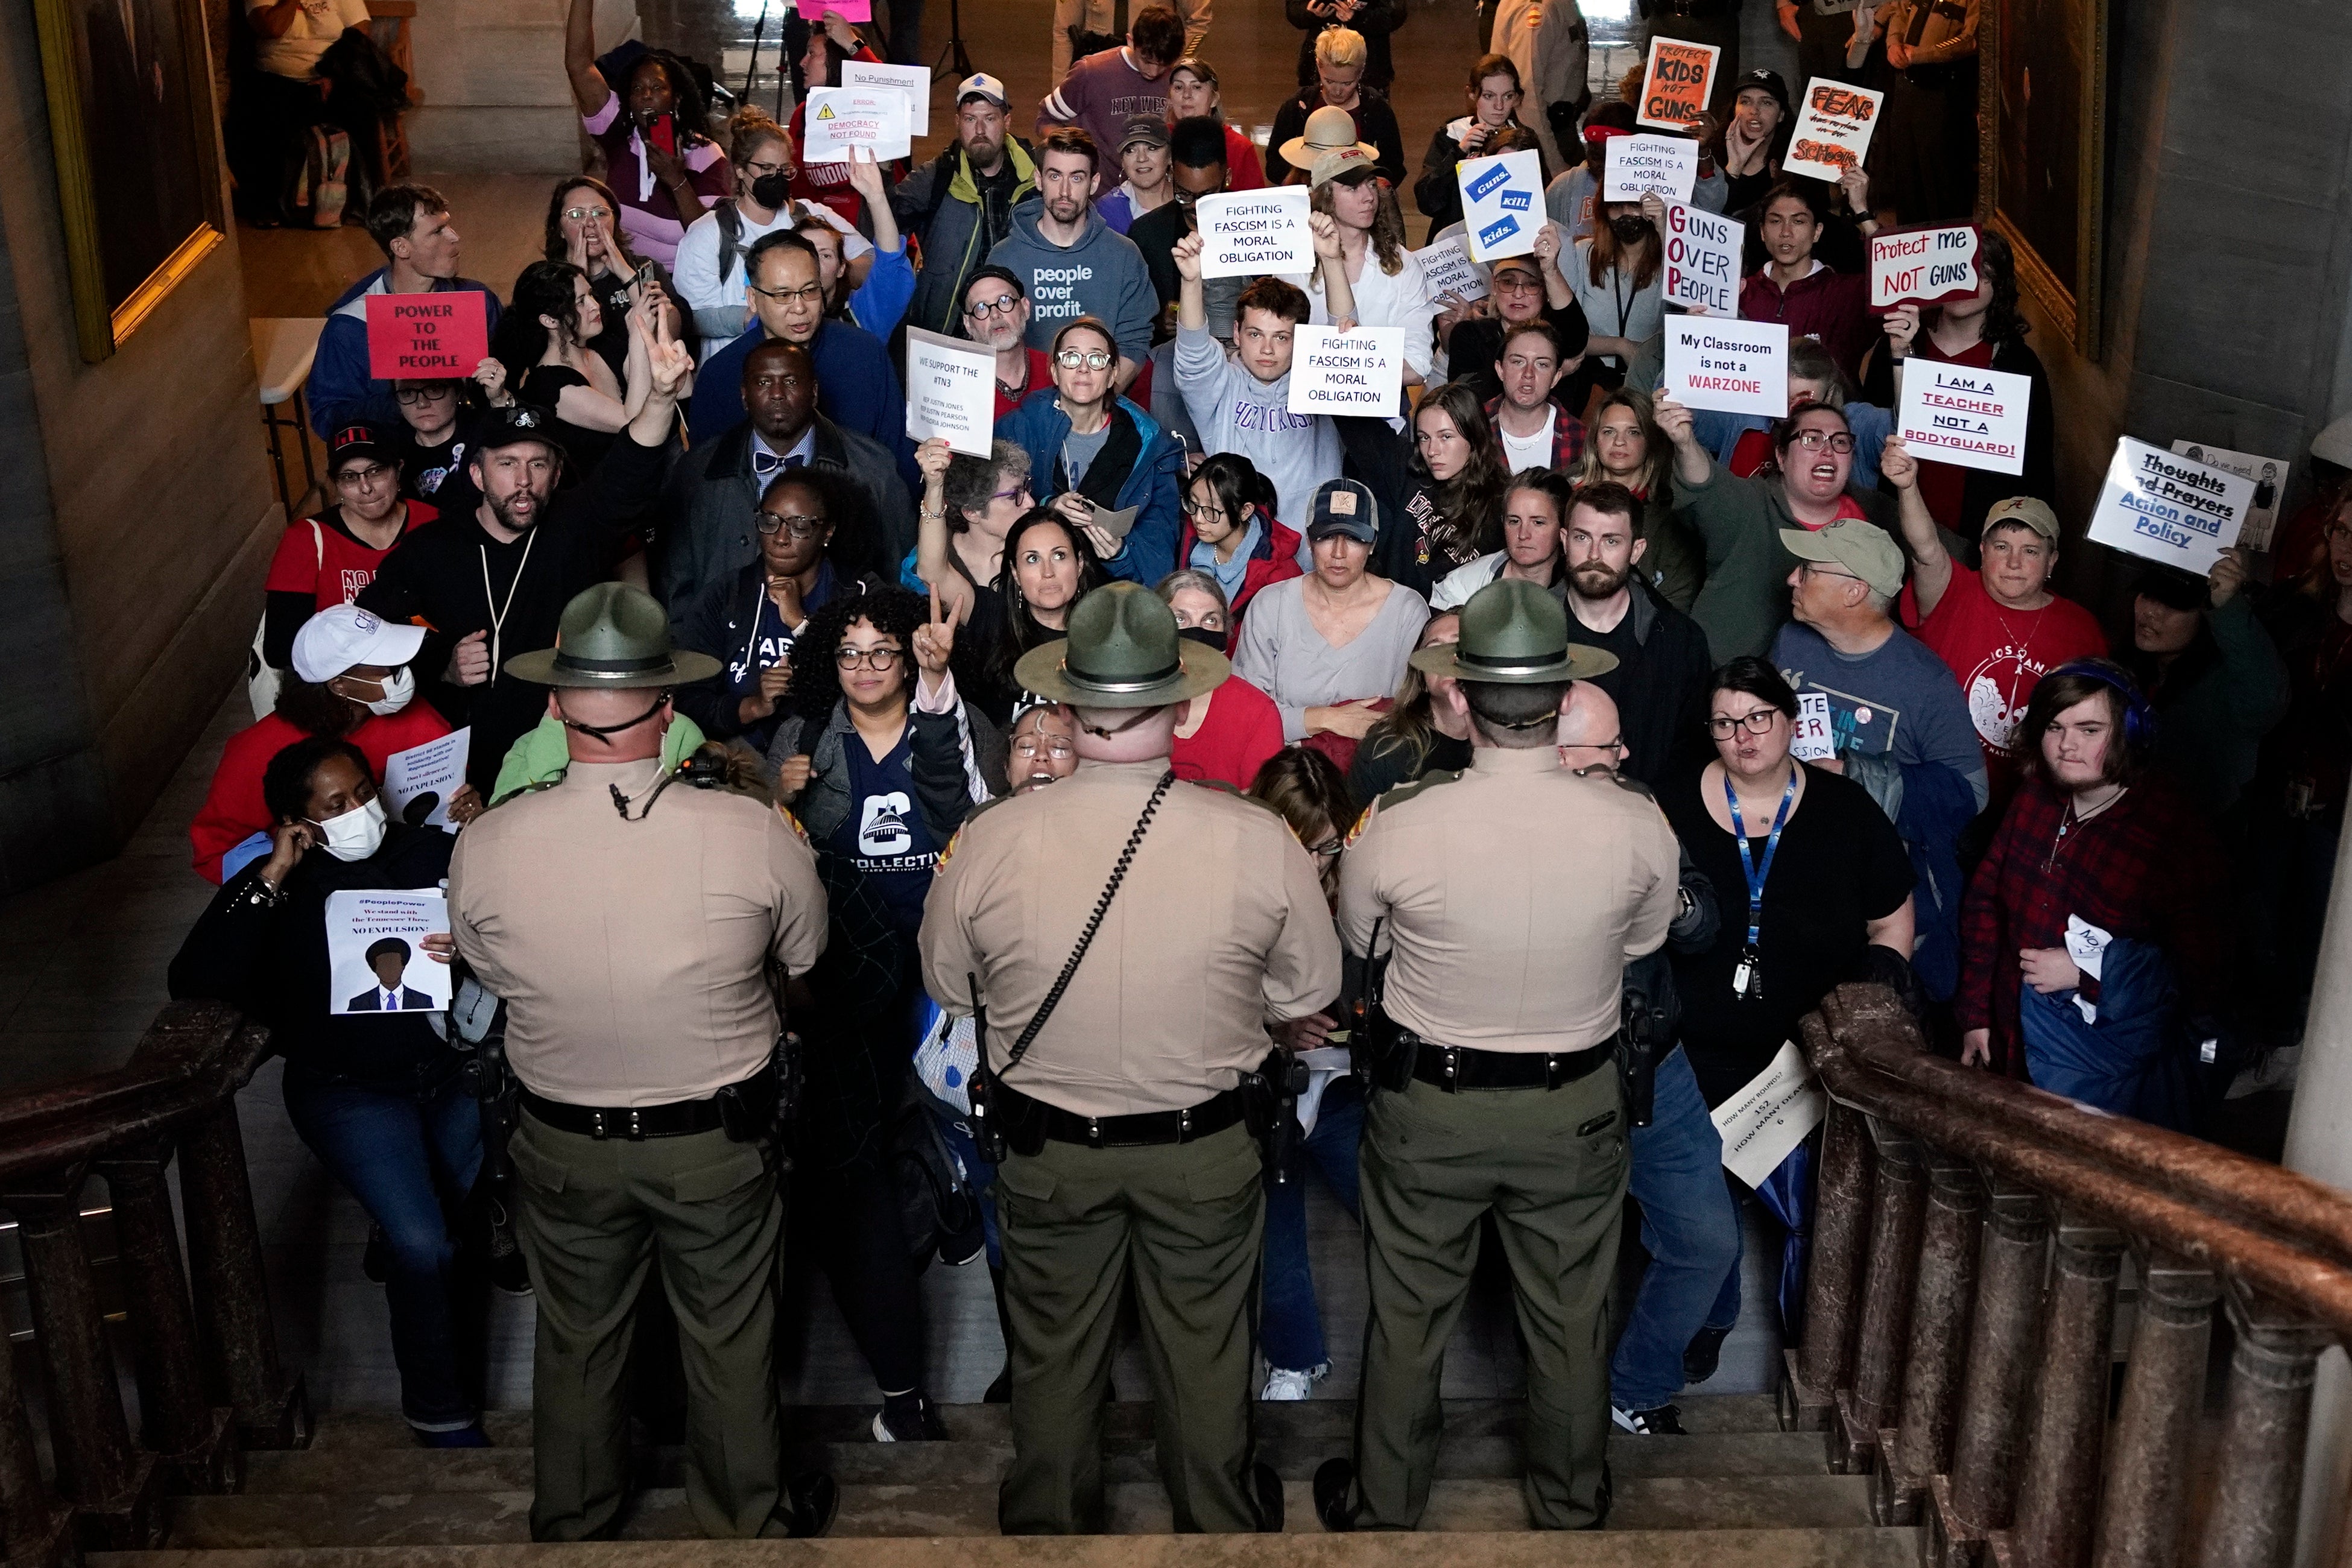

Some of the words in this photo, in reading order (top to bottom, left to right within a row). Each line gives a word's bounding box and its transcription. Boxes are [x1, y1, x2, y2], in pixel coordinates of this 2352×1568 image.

[1660, 45, 1712, 60] PROTECT
[1656, 58, 1704, 84] KIDS
[868, 75, 914, 86] Punishment
[1661, 84, 1690, 95] NOT
[1111, 96, 1136, 115] KEY
[1140, 96, 1169, 113] WES
[1647, 96, 1696, 119] GUNS
[1812, 86, 1874, 121] FEAR
[828, 120, 879, 129] DEMOCRACY
[1630, 143, 1675, 155] FIGHTING
[1619, 157, 1661, 166] FASCISM
[1665, 160, 1674, 168] IS
[1677, 161, 1684, 170] A
[806, 162, 851, 186] FUNDIN
[1634, 171, 1667, 181] MORAL
[1620, 183, 1677, 195] OBLIGATION
[1226, 204, 1282, 216] FIGHTING
[1215, 220, 1267, 232] FASCISM
[1271, 220, 1282, 229] IS
[1286, 219, 1294, 229] A
[1669, 206, 1728, 244] GUNS
[1234, 236, 1277, 246] MORAL
[1874, 234, 1931, 262] Protect
[1938, 231, 1967, 250] me
[1219, 251, 1293, 264] OBLIGATION
[1421, 245, 1461, 267] FIGHTING
[1668, 238, 1730, 283] OVER
[1034, 264, 1093, 285] people
[1425, 262, 1458, 279] ASCISM
[1459, 257, 1467, 268] IS
[1437, 270, 1468, 288] MORAL
[1884, 266, 1926, 296] NOT
[1930, 262, 1967, 286] GUNS
[1034, 286, 1073, 300] over
[1433, 278, 1484, 304] OBLATION
[1668, 266, 1730, 311] PEOPLE
[394, 305, 453, 318] POWER
[1035, 300, 1086, 322] profit.
[413, 322, 436, 334] TO
[411, 339, 441, 350] THE
[1322, 338, 1376, 350] FIGHTING
[1681, 334, 1700, 349] My
[1704, 336, 1771, 355] Classroom
[399, 355, 459, 367] PEOPLE
[920, 356, 928, 367] WE
[929, 359, 960, 375] SUPPORT
[963, 367, 978, 378] THE
[1309, 356, 1360, 368] FASCISM
[1365, 358, 1374, 368] IS
[1379, 358, 1386, 368] A
[1701, 356, 1711, 368] is
[1715, 361, 1736, 370] not
[934, 376, 951, 387] #TN3
[1326, 373, 1367, 385] MORAL
[1689, 375, 1760, 393] WARZONE
[1937, 373, 1941, 384] I
[1950, 378, 1974, 389] AM
[1983, 382, 1994, 392] A
[1309, 390, 1380, 402] OBLIGATION
[1923, 393, 2003, 415] TEACHER
[941, 411, 968, 421] PEARSON
[1934, 414, 1970, 428] NOT
[1977, 422, 1989, 432] A
[940, 422, 969, 431] JOHNSON
[1905, 429, 2015, 455] BODYGUARD!
[2144, 453, 2227, 493] Thoughts
[2206, 454, 2219, 467] Do
[2221, 460, 2231, 469] we
[2233, 464, 2251, 475] need
[2135, 475, 2160, 492] nd
[2163, 481, 2234, 517] Prayers
[2120, 491, 2179, 520] Action
[2184, 519, 2222, 534] and
[2135, 515, 2193, 548] Policy
[1800, 698, 1826, 714] TE
[1795, 718, 1824, 739] ER
[1794, 745, 1829, 757] SSION
[410, 773, 455, 791] EXPULSION!
[1722, 1113, 1738, 1127] HOW
[1738, 1096, 1756, 1114] MANY
[1756, 1072, 1783, 1098] ROUNDS?
[1754, 1100, 1771, 1115] 152
[1734, 1130, 1756, 1152] HOW
[1756, 1105, 1780, 1130] MANY
